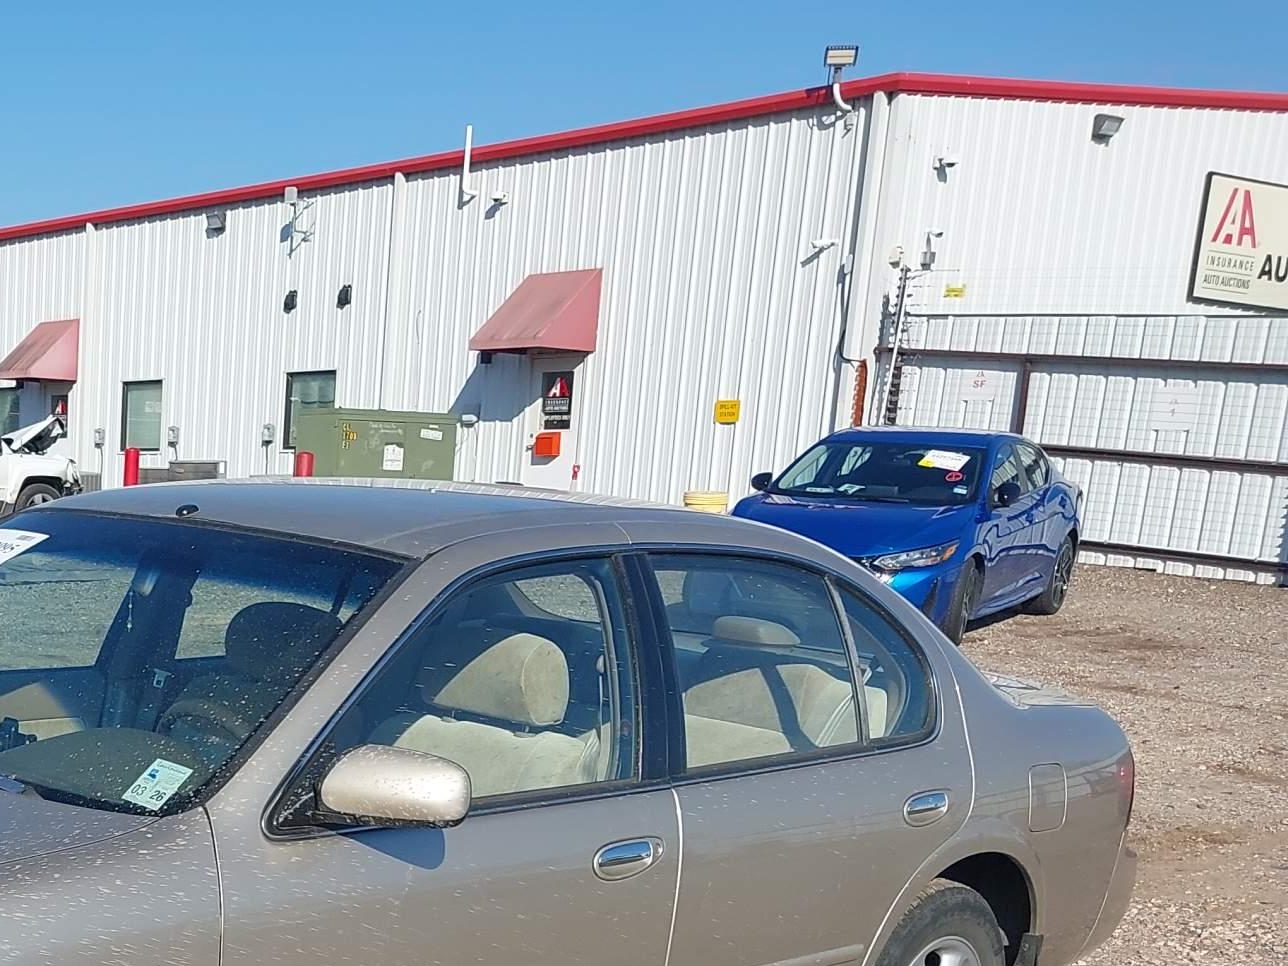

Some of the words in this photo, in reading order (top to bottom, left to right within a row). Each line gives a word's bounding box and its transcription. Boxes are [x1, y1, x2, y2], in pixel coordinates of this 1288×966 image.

[1206, 255, 1255, 272] INSURANCE
[1202, 274, 1220, 286] AUTO
[1220, 275, 1251, 289] AUCTIONS
[130, 783, 149, 797] 03
[148, 789, 168, 803] 26
